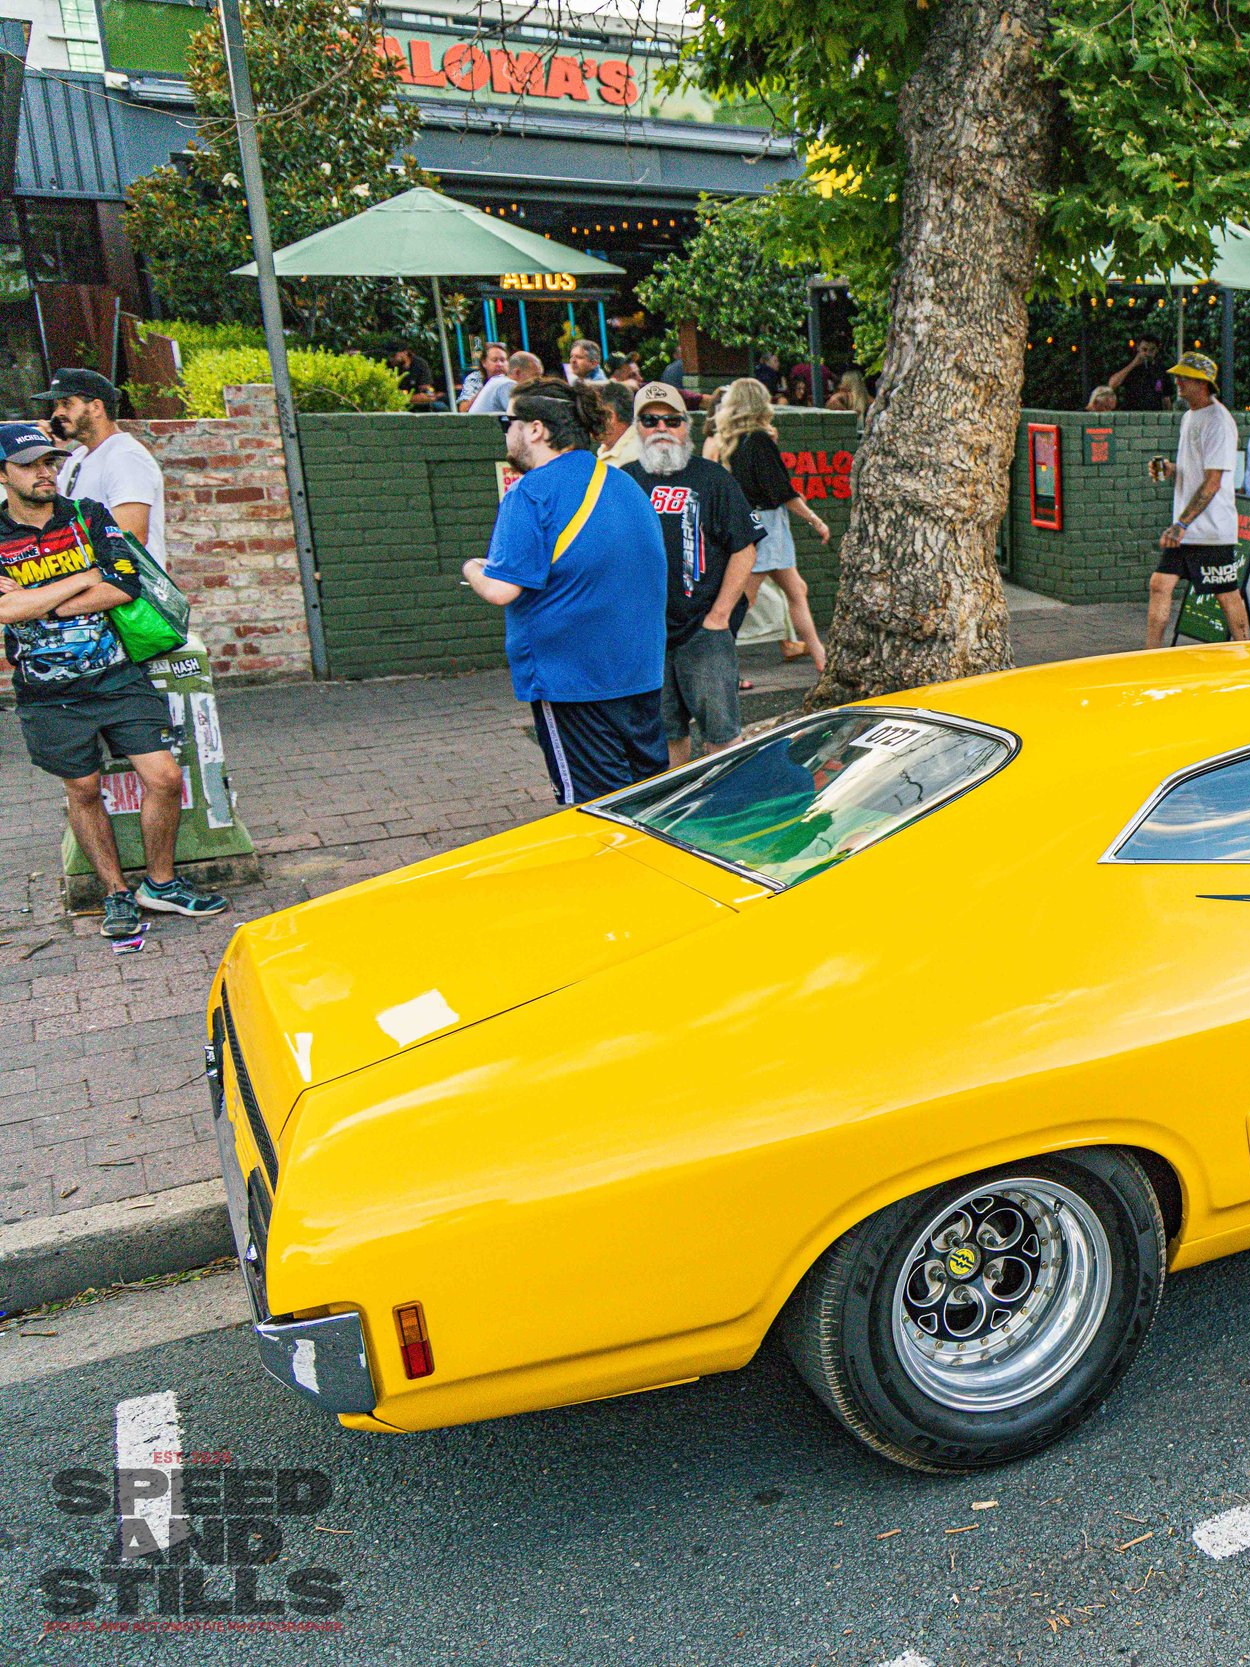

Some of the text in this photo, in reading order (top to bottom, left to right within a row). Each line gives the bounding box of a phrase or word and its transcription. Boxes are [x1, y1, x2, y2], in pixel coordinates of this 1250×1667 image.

[330, 31, 638, 106] ALOMA'S
[780, 449, 855, 475] PALO
[171, 657, 200, 675] HASH
